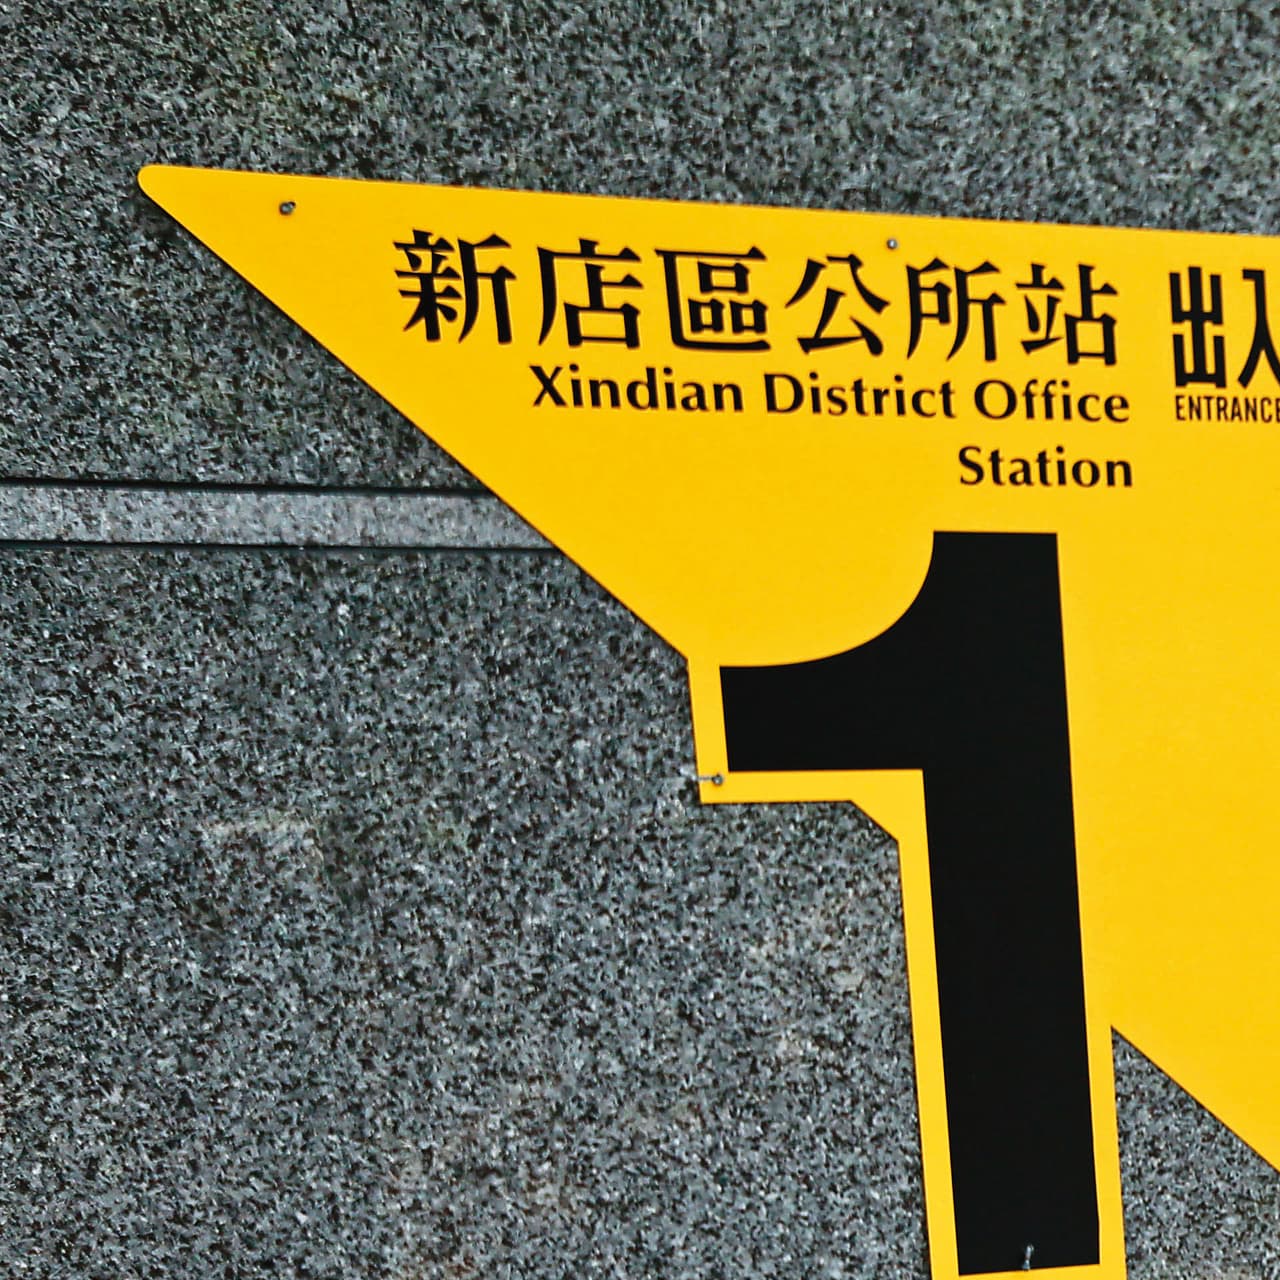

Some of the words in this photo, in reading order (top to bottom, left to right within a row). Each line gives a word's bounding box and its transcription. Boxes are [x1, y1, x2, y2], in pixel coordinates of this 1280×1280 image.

[393, 229, 1119, 367] 新店區公所站
[529, 363, 744, 412] Xindian
[763, 372, 954, 418] District
[973, 379, 1130, 423] Office
[958, 446, 1133, 488] Station
[720, 531, 1100, 1276] 1
